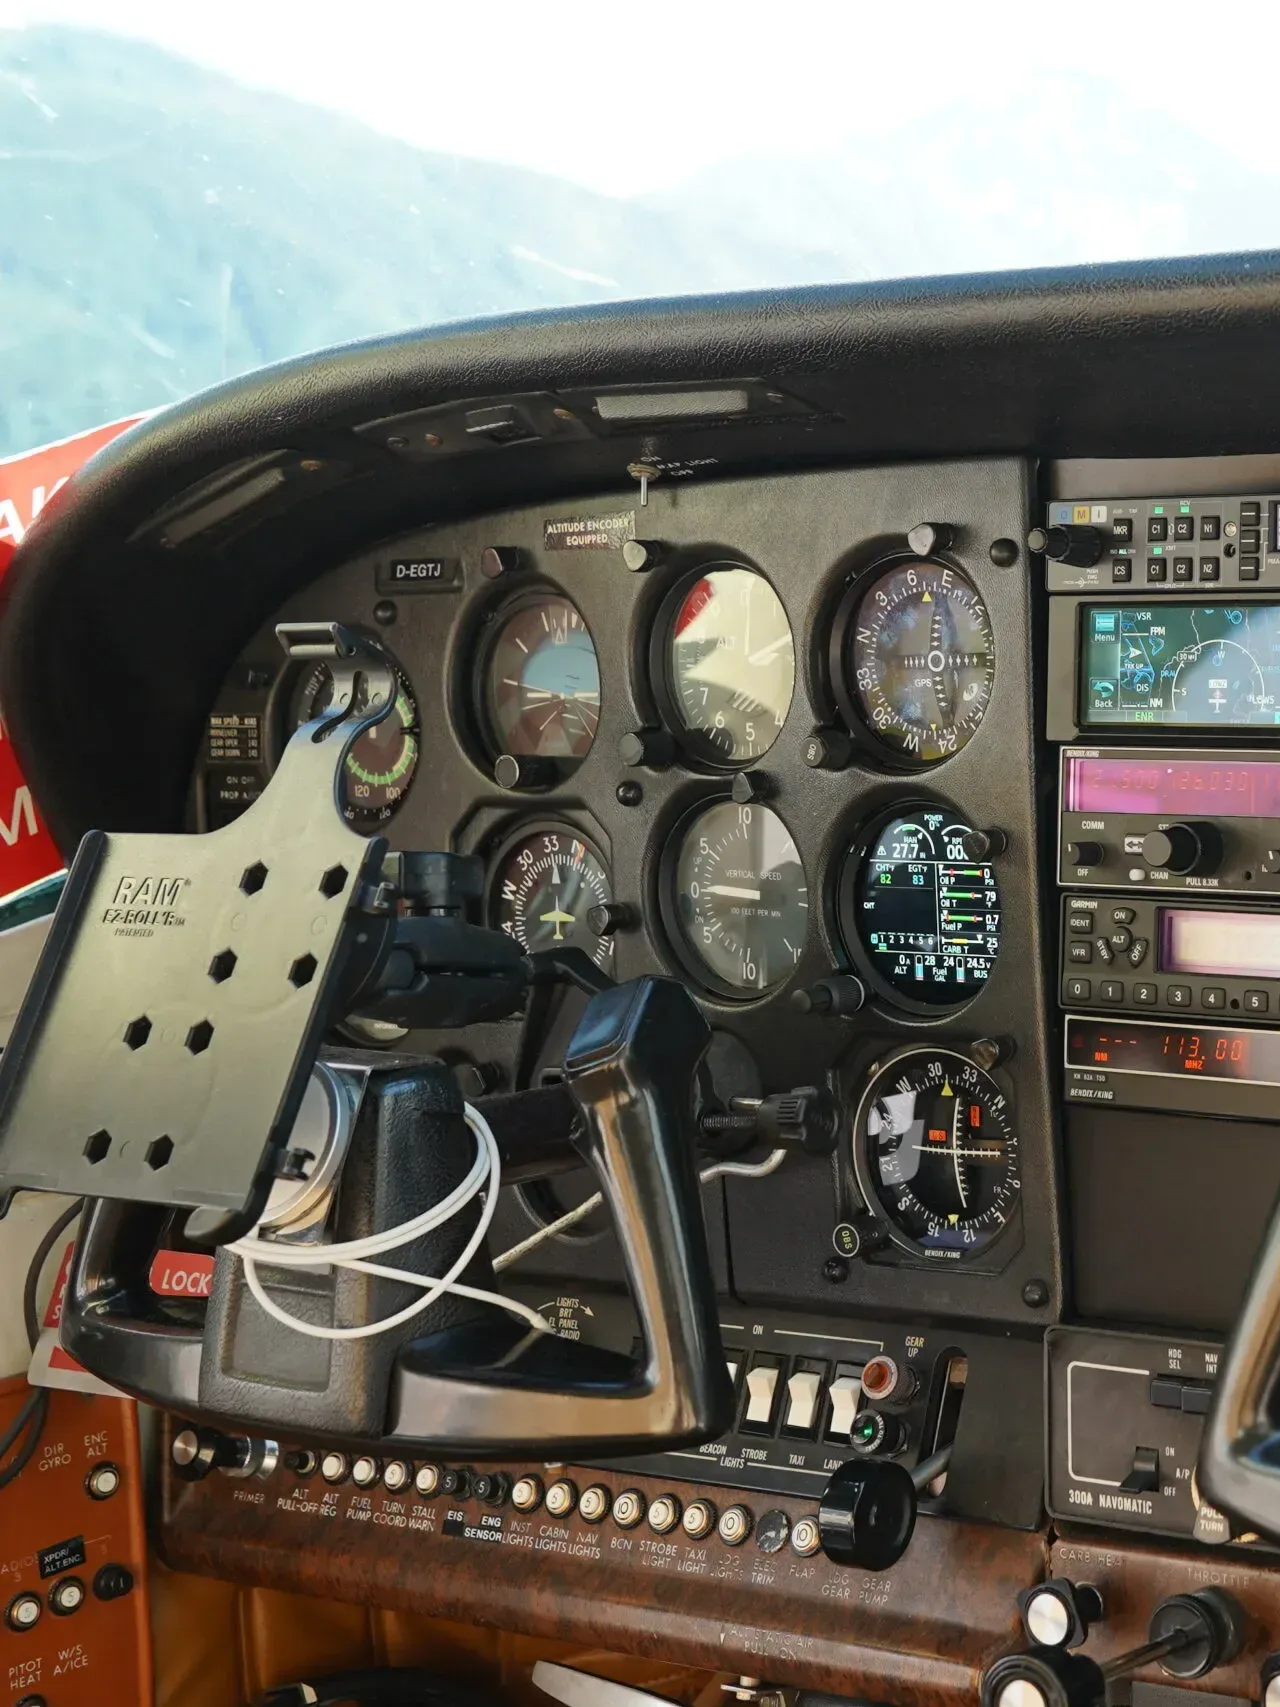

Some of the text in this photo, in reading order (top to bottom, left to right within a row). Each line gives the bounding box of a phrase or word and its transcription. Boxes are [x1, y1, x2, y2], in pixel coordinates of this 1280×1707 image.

[548, 518, 628, 533] ALTITUDE ENCODER
[1113, 526, 1128, 535] MKR
[1151, 525, 1160, 534] C1
[1178, 524, 1187, 533] C2
[1204, 523, 1213, 533] N1
[566, 534, 608, 546] EQUIPPED
[396, 563, 440, 578] D-EGTJ
[1114, 566, 1126, 575] ICS
[906, 569, 918, 586] 6
[942, 569, 954, 588] E
[1136, 613, 1151, 621] VSR
[1095, 633, 1115, 642] Menu
[1151, 627, 1165, 636] FPM
[857, 667, 872, 691] 33
[914, 678, 932, 688] GPS
[1136, 684, 1149, 692] DIS
[1095, 700, 1113, 708] Back
[1150, 699, 1163, 708] NM
[873, 706, 892, 729] 30
[1135, 711, 1154, 721] ENR
[938, 734, 957, 754] 24
[354, 784, 370, 797] 120
[739, 806, 752, 825] 10
[924, 814, 944, 822] POWER
[1081, 820, 1105, 829] COMM
[543, 835, 560, 853] 33
[892, 843, 920, 859] 27.7
[516, 849, 534, 871] 30
[725, 869, 782, 881] VERTICAL SPEED
[1077, 868, 1088, 876] OFF
[1150, 871, 1168, 880] CHAN
[880, 874, 892, 884] 82
[912, 875, 925, 885] 83
[1186, 877, 1201, 886] PULL
[984, 891, 997, 902] 79
[1071, 900, 1098, 908] GARMIN
[1114, 911, 1126, 919] ON
[1072, 948, 1086, 956] VFR
[1096, 940, 1109, 960] STBY
[1131, 944, 1142, 961] OFF
[924, 956, 936, 966] 28
[943, 956, 955, 967] 24
[742, 962, 756, 981] 10
[894, 967, 907, 975] ALT
[933, 967, 948, 975] Fuel
[974, 970, 988, 979] BUS
[1163, 1036, 1243, 1061] 113.00
[928, 1063, 942, 1077] 30
[963, 1066, 978, 1083] 33
[1070, 1087, 1113, 1100] BENDIX/KING
[882, 1157, 893, 1172] 21
[841, 1230, 853, 1249] OBS
[963, 1229, 977, 1243] 12
[161, 1269, 212, 1294] LOCK
[556, 1297, 579, 1308] LIGHTS
[559, 1308, 572, 1318] BRT
[559, 1318, 578, 1330] PANEL
[752, 1325, 763, 1336] ON
[561, 1329, 581, 1341] RADIO
[905, 1336, 924, 1348] GEAR
[908, 1347, 919, 1358] UP
[1168, 1348, 1182, 1359] HDG
[1205, 1353, 1218, 1364] NAV
[1169, 1359, 1181, 1370] SEL
[1206, 1364, 1218, 1374] INT
[84, 1430, 108, 1447] ENC
[44, 1442, 65, 1458] DIR
[87, 1443, 108, 1458] ALT
[741, 1448, 767, 1461] STROBE
[1165, 1446, 1175, 1457] ON
[38, 1453, 72, 1471] GYRO
[720, 1456, 745, 1469] LIGHTS
[789, 1454, 804, 1466] TAXI
[1176, 1468, 1190, 1481] A/P
[234, 1490, 265, 1504] PRIMER
[292, 1487, 310, 1500] ALT
[1164, 1485, 1176, 1497] OFF
[323, 1492, 340, 1504] ALT
[351, 1495, 371, 1510] FUEL
[1068, 1489, 1153, 1515] 300A NAVOMATIC
[277, 1498, 318, 1514] PULL-OFF
[319, 1503, 337, 1517] REG
[382, 1500, 405, 1514] TURN
[412, 1504, 436, 1520] STALL
[346, 1508, 371, 1521] PUMP
[373, 1512, 407, 1527] COORD
[447, 1510, 464, 1522] EIS
[481, 1515, 502, 1527] ENG
[408, 1516, 435, 1532] WARN
[510, 1520, 532, 1534] INST
[1200, 1520, 1224, 1533] TURN
[464, 1527, 502, 1542] SENSOR
[539, 1525, 570, 1540] CABIN
[577, 1531, 600, 1544] NAV
[502, 1532, 534, 1549] LIGHTS
[534, 1538, 567, 1554] LIGHTS
[610, 1536, 632, 1551] BCN
[568, 1543, 600, 1560] LIGHTS
[639, 1539, 678, 1557] STROBE
[685, 1546, 707, 1560] TAXI
[642, 1553, 671, 1569] LIGHT
[1059, 1548, 1092, 1563] CARB
[677, 1559, 707, 1575] LIGHT
[788, 1563, 816, 1579] FLAP
[1187, 1567, 1250, 1586] THROTTLE
[821, 1583, 851, 1599] GEAR
[862, 1576, 892, 1593] GEAR
[859, 1591, 889, 1607] PUMP
[58, 1644, 83, 1661] W/S
[9, 1657, 42, 1678] PITOT
[53, 1655, 89, 1677] A/ICE
[10, 1671, 42, 1691] HEAT
